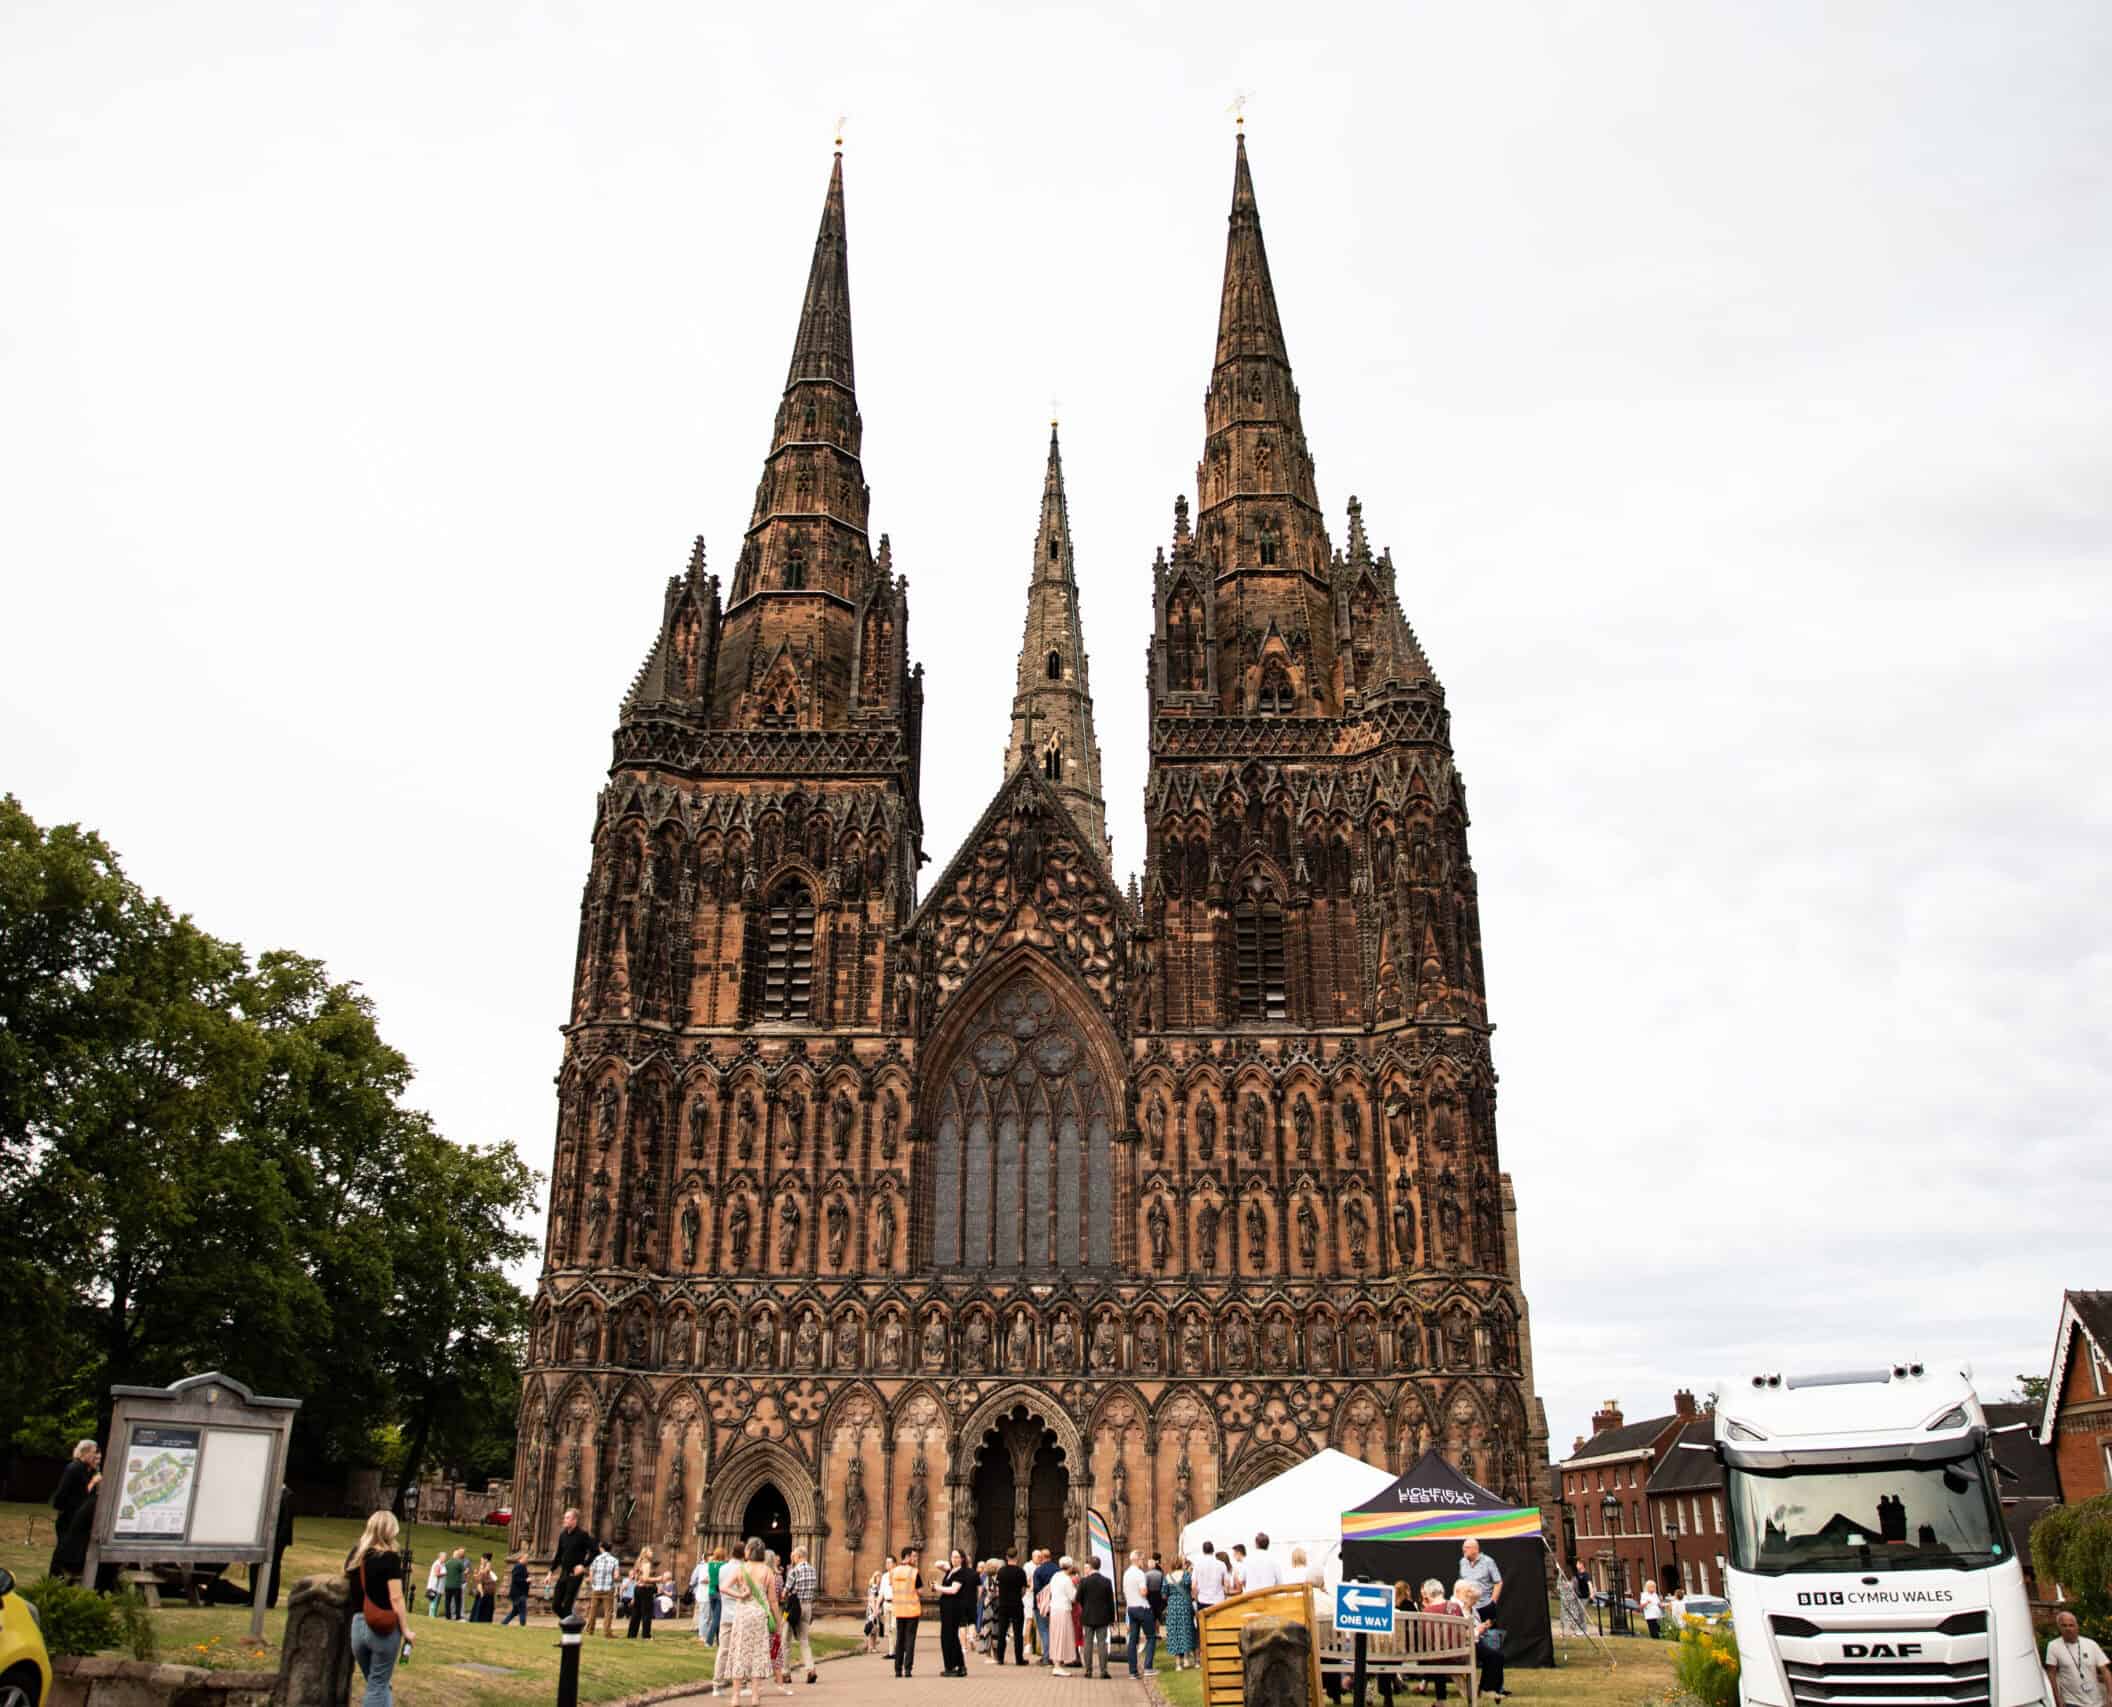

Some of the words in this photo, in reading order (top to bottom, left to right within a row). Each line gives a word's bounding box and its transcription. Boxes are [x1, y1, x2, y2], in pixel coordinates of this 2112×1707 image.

[1398, 1487, 1474, 1500] LICHFIELD
[1399, 1494, 1478, 1505] FESTIVAL
[1797, 1591, 1844, 1605] BBC
[1847, 1591, 1899, 1604] CYMRU
[1903, 1590, 1953, 1602] WALES
[1340, 1614, 1361, 1625] ONE
[1364, 1615, 1388, 1627] WAY
[1842, 1643, 1922, 1658] DAF
